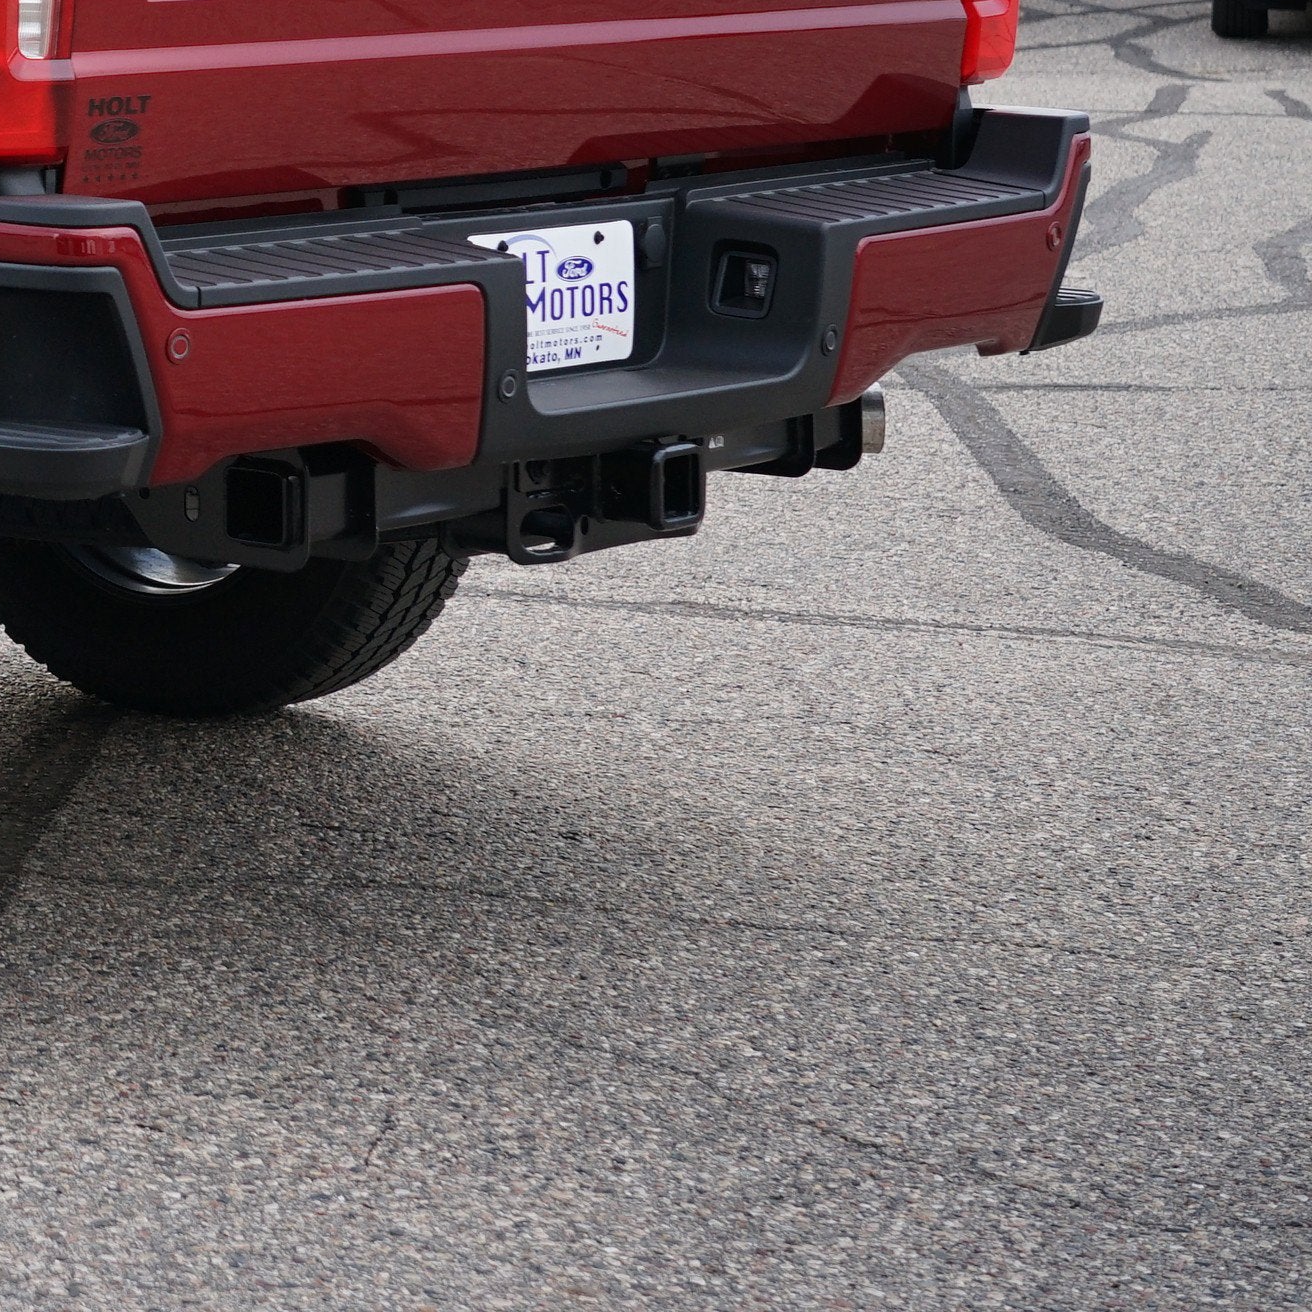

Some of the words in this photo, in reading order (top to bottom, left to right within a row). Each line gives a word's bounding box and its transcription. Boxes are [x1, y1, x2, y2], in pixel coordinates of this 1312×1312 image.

[87, 95, 152, 117] HOLT
[84, 145, 144, 161] MOTORS
[522, 250, 550, 285] LT
[561, 259, 589, 278] Ford
[525, 280, 628, 323] MOTORS
[526, 334, 603, 350] oltmotors.com
[526, 351, 561, 366] okato,
[564, 346, 582, 360] MN
